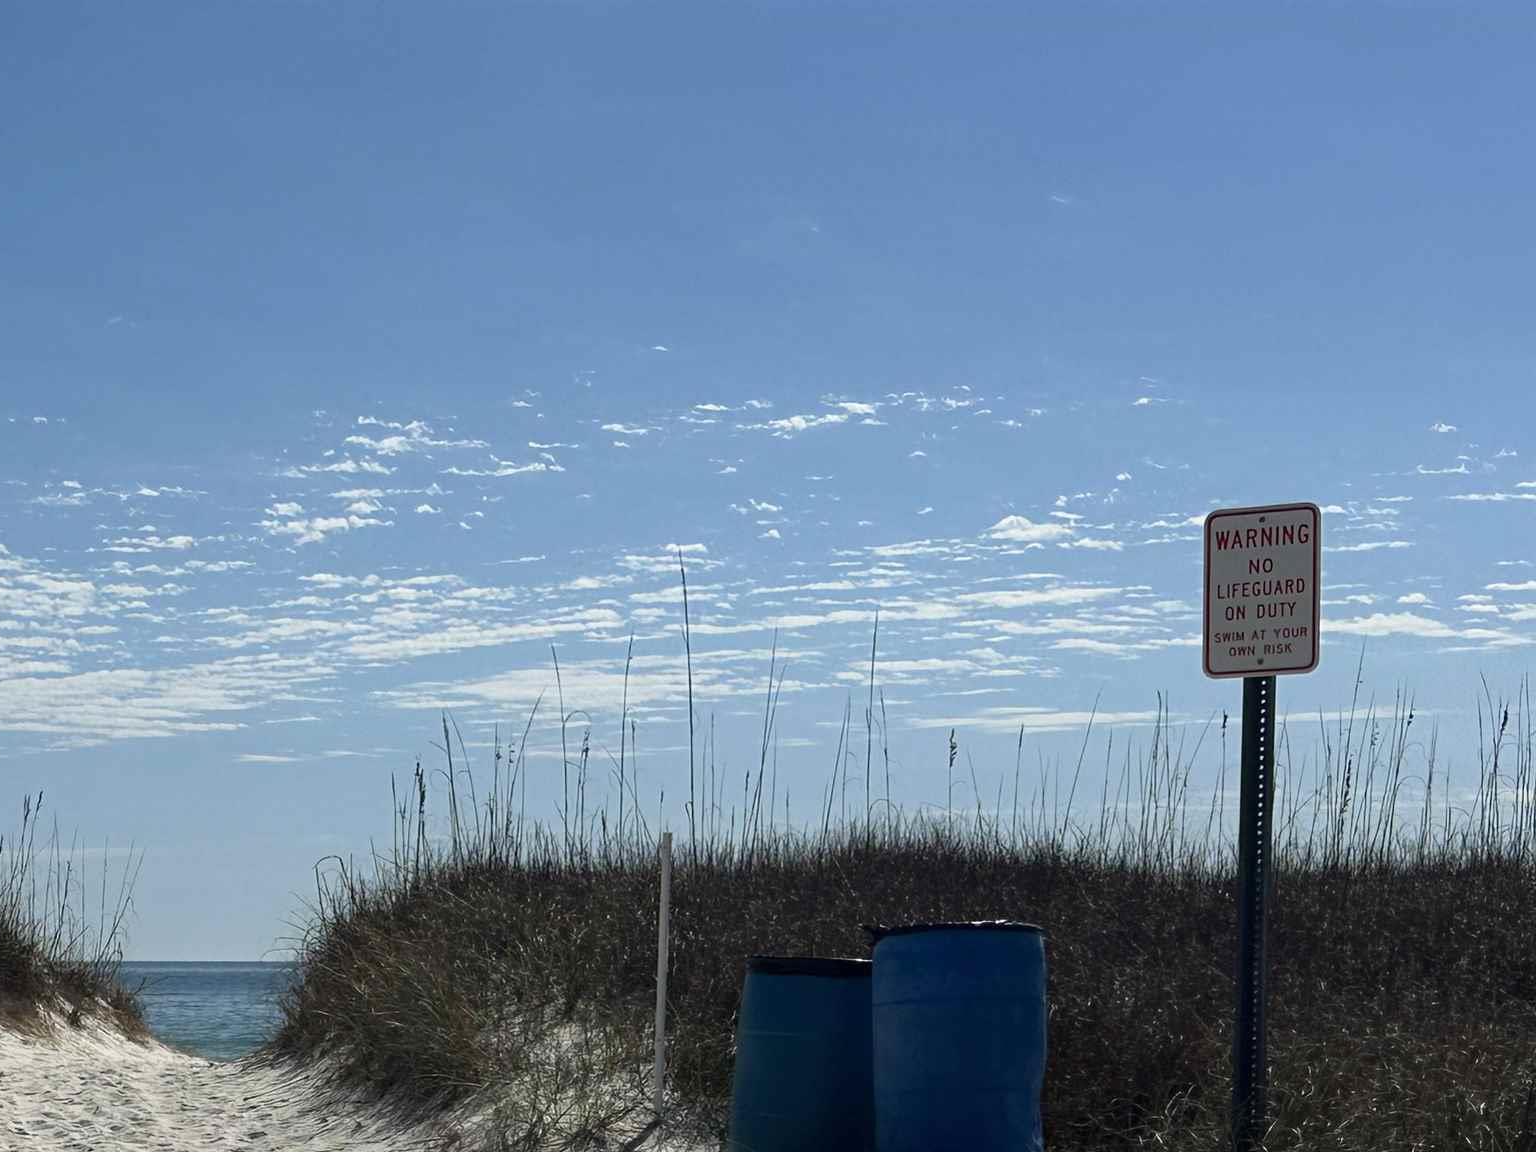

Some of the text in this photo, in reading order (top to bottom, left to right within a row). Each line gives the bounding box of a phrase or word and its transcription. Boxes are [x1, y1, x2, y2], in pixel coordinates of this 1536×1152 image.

[1215, 524, 1309, 550] WARNING
[1249, 558, 1273, 575] NO
[1217, 578, 1305, 600] LIFEGUARD
[1225, 602, 1296, 621] ON DUTY
[1214, 627, 1308, 643] SWIM AT YOUR
[1229, 643, 1292, 657] OWN RISK
